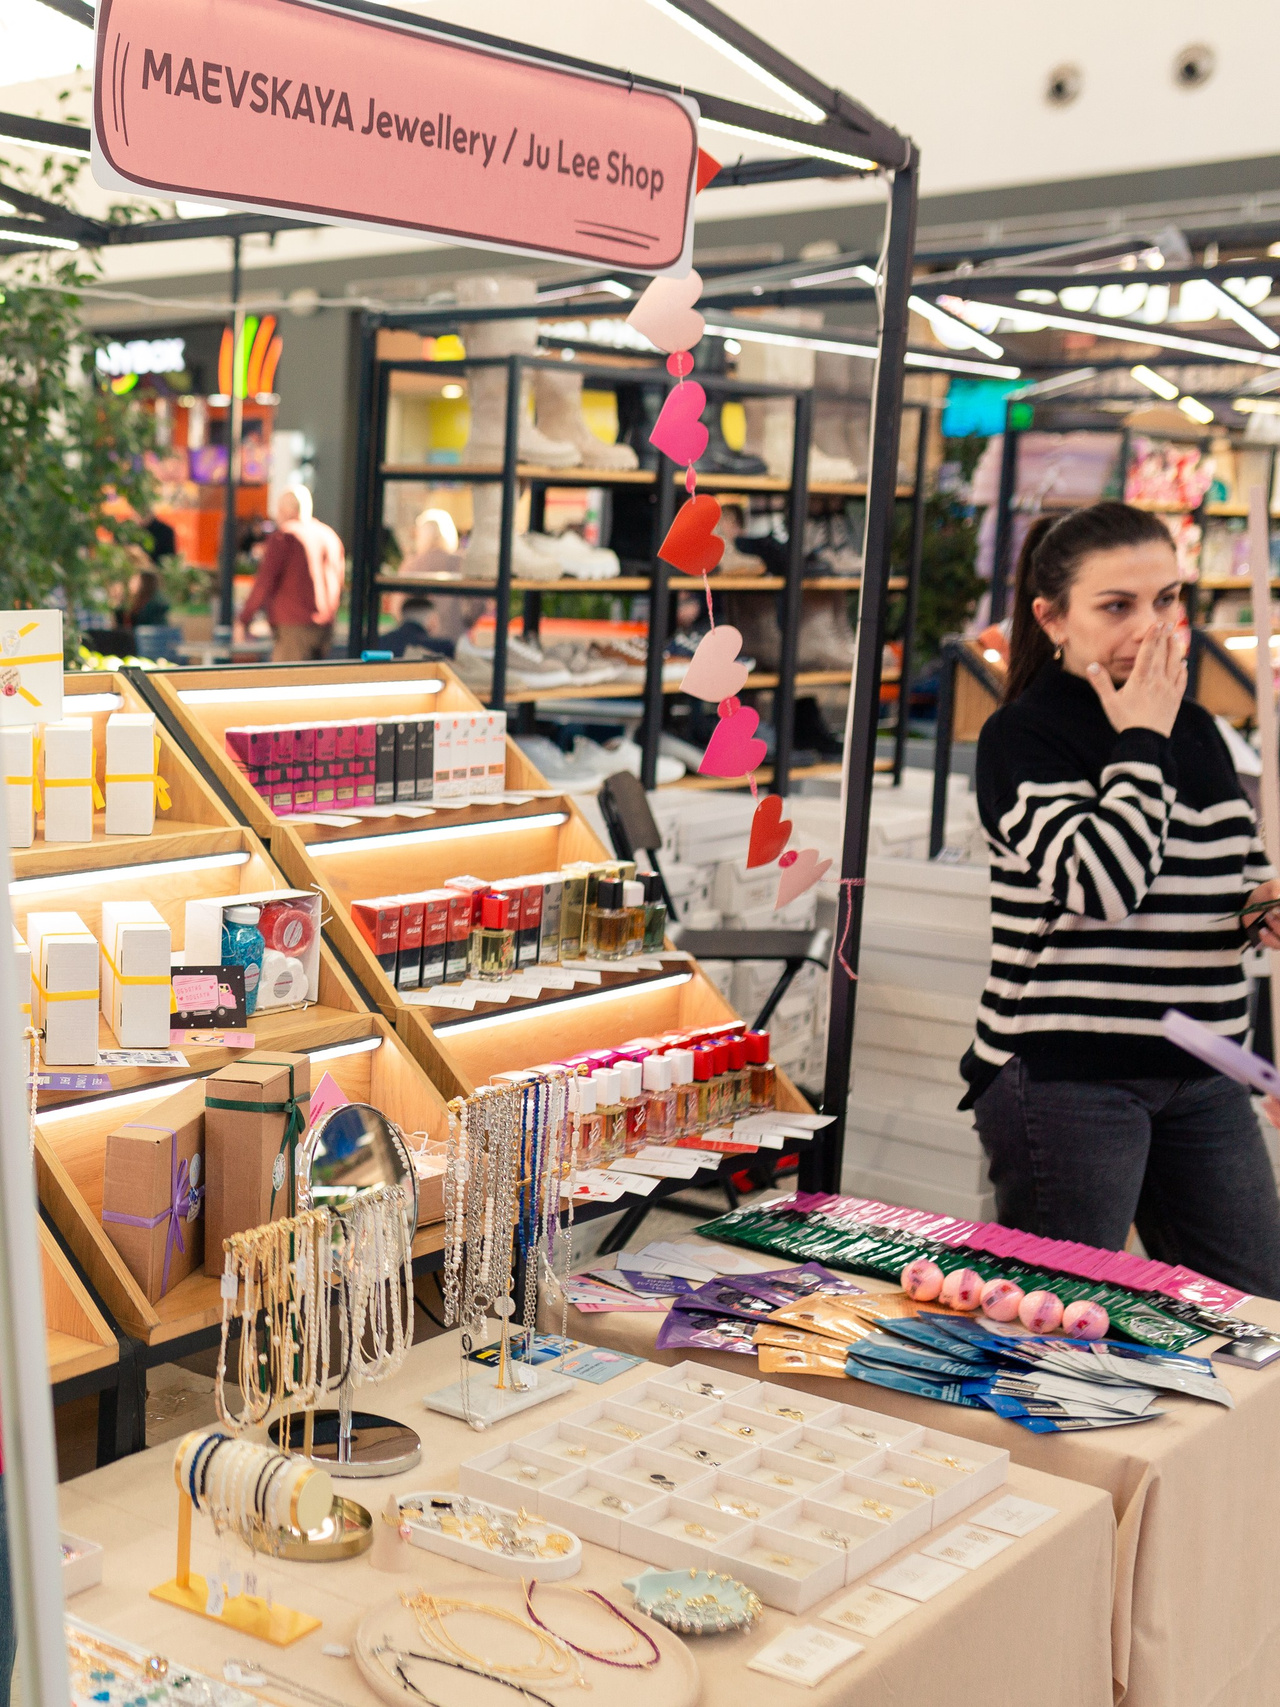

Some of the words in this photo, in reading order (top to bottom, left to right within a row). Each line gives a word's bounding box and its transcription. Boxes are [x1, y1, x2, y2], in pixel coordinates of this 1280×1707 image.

[141, 48, 355, 132] MAEVSKAYA
[360, 97, 498, 169] Jewellery
[502, 127, 518, 165] /
[522, 132, 551, 171] Ju
[557, 139, 601, 181] Lee
[606, 149, 664, 201] Shop
